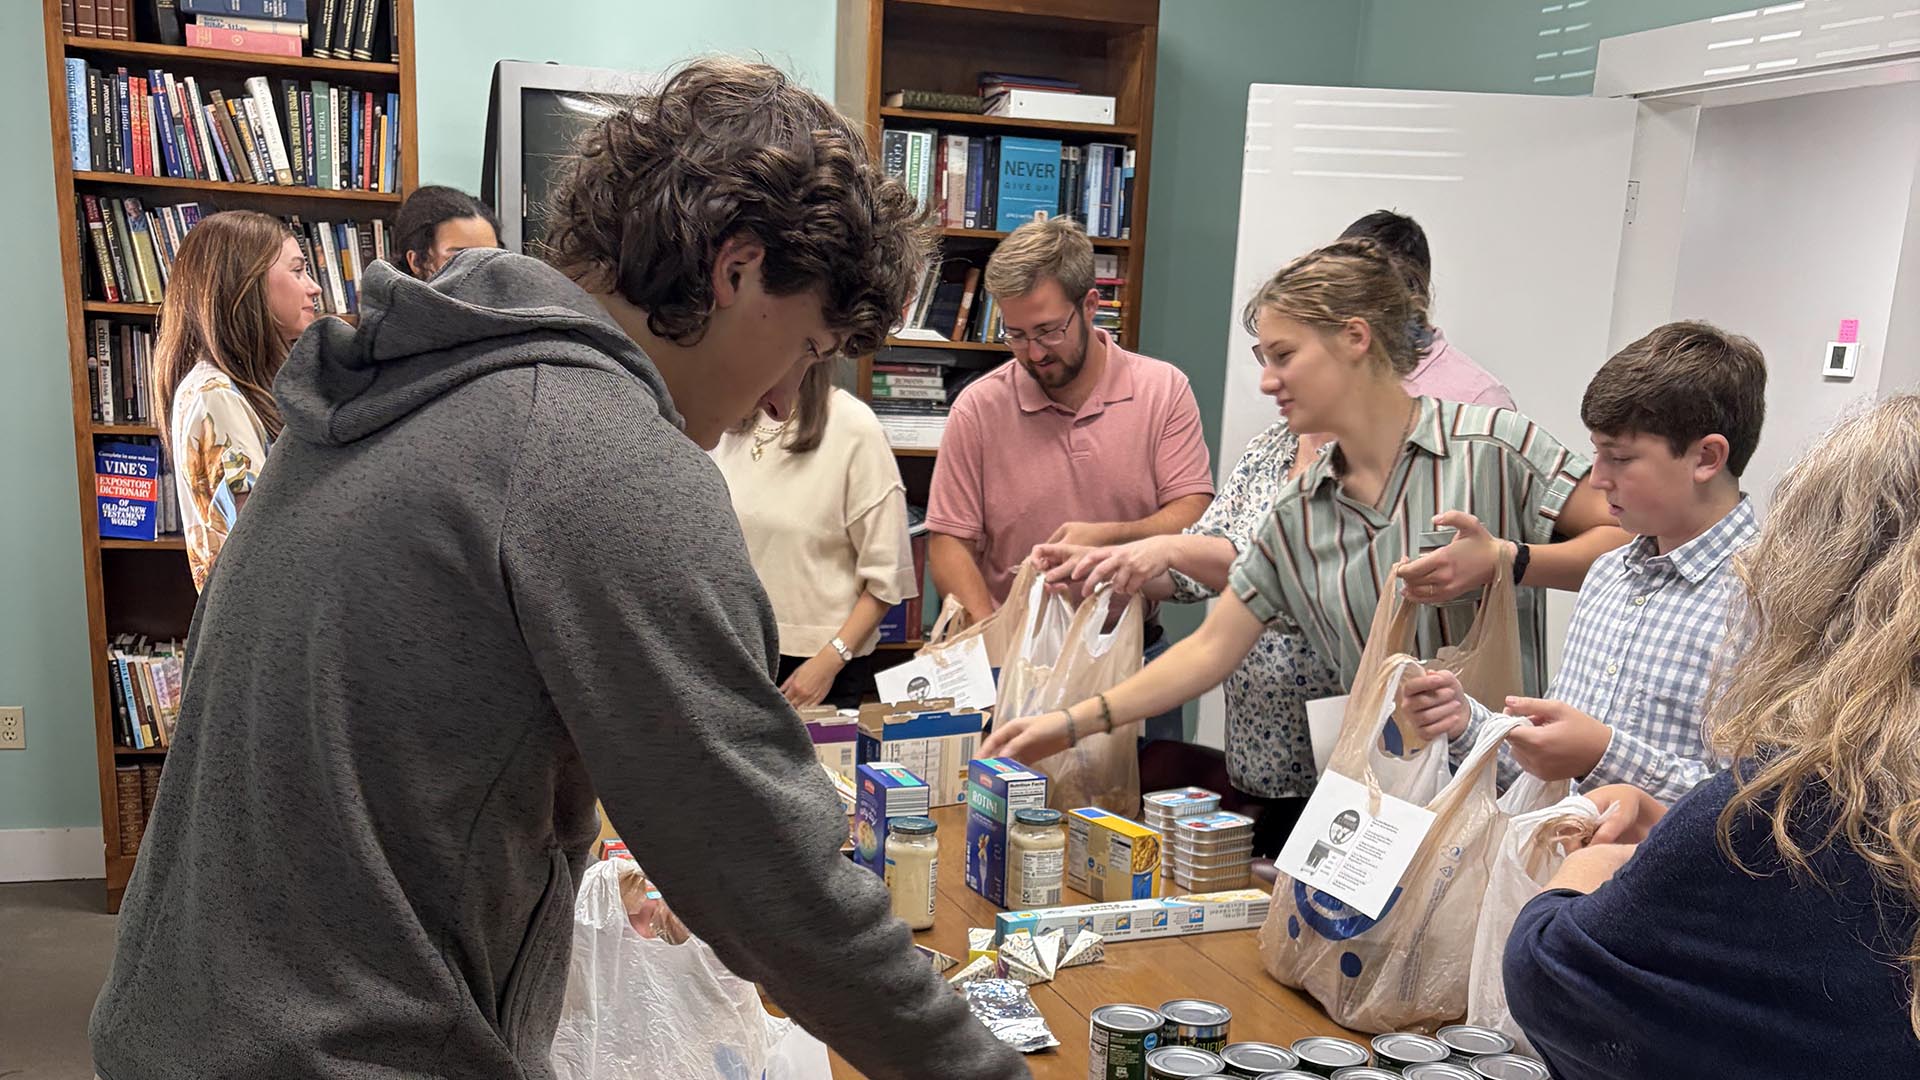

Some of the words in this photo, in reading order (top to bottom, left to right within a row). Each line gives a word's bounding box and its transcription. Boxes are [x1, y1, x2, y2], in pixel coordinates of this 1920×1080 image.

[288, 90, 299, 110] PURPOSE
[340, 91, 348, 118] FACING
[290, 111, 300, 127] DRIVEN
[318, 111, 326, 130] YOGI
[291, 128, 301, 146] CHURCH
[340, 119, 348, 143] DEATH
[1005, 160, 1055, 179] NEVER
[1004, 181, 1031, 190] GIVE
[105, 461, 147, 476] VINE'S
[100, 476, 152, 489] EXPOSITORY
[100, 486, 150, 498] DICTIONARY
[102, 503, 118, 511] OLD
[129, 506, 146, 514] NEW
[103, 510, 146, 521] TESTAMENT
[111, 518, 137, 527] WORDS
[972, 790, 998, 814] ROTINI
